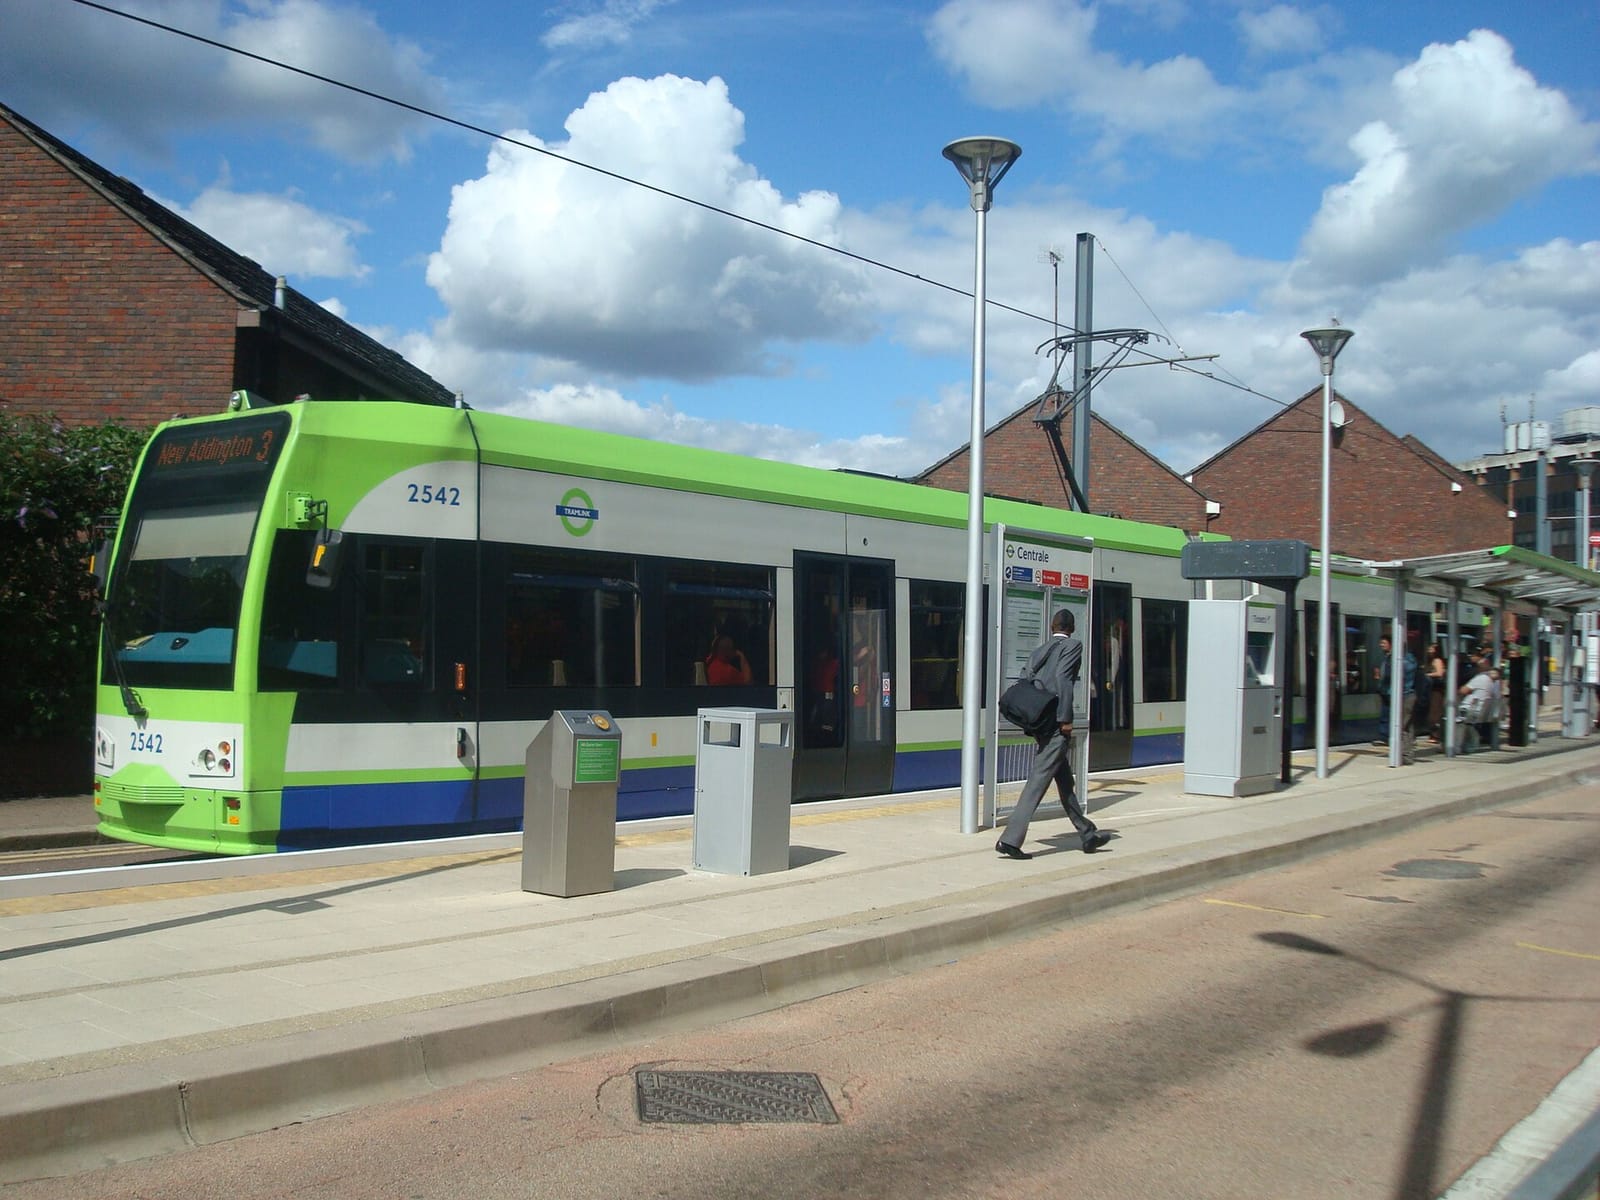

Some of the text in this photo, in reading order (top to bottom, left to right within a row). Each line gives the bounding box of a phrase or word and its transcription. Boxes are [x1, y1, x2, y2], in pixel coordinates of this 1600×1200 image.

[158, 428, 274, 465] New Addington 3
[407, 483, 461, 506] 2542
[564, 507, 591, 518] TRAMLINK
[1017, 546, 1049, 563] Centrale
[130, 731, 163, 754] 2542
